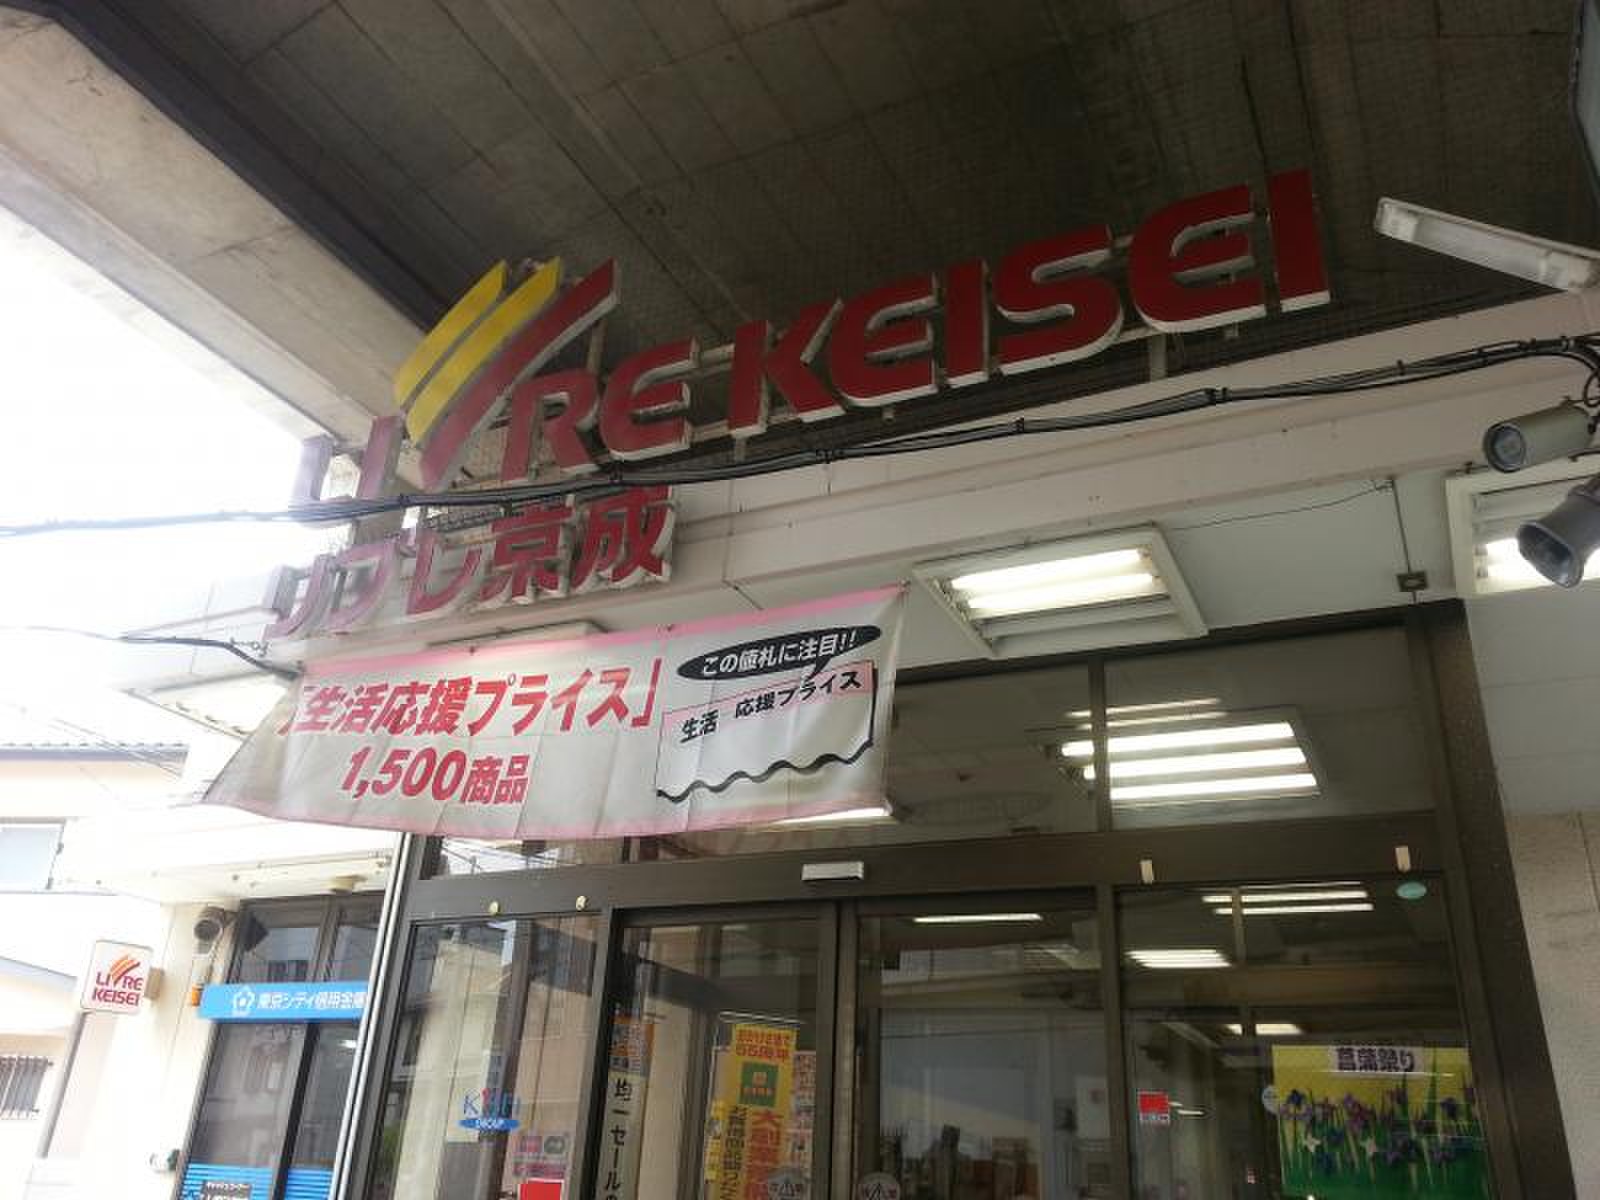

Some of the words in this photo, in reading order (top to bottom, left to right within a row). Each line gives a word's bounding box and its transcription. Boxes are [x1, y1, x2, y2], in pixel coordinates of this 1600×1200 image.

[727, 168, 1331, 436] KEISEI
[703, 629, 856, 677] この値札に注目!!
[680, 709, 718, 743] 生活
[341, 747, 530, 804] 1,500商品
[91, 986, 140, 1007] KEISEI
